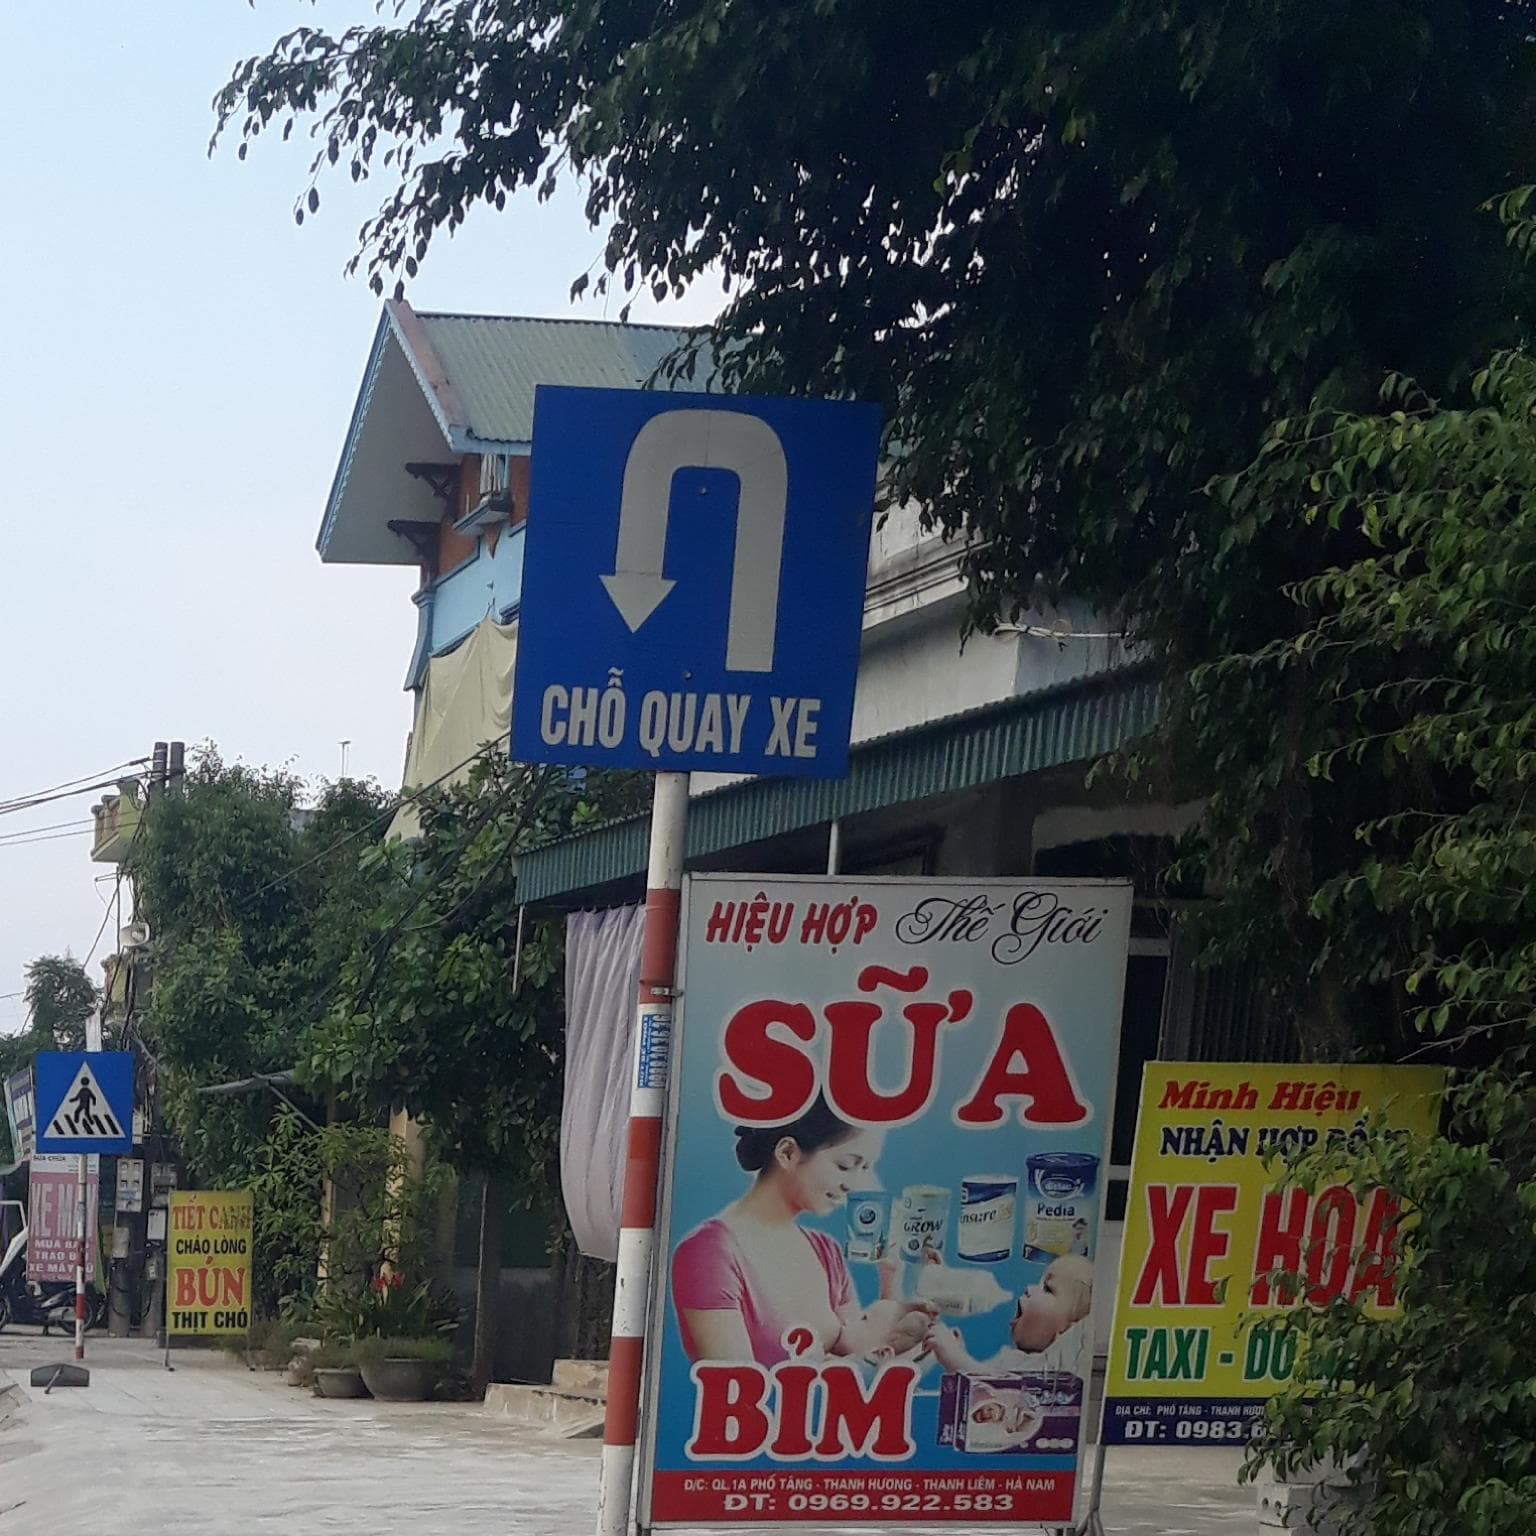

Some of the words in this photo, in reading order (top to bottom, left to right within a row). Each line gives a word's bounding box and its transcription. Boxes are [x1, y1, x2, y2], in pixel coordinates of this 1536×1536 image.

[541, 667, 626, 750] CHỖ
[639, 690, 751, 758] QUAY
[764, 697, 821, 759] XE
[706, 892, 790, 952] HIỆU
[800, 896, 878, 955] HỢP
[895, 894, 1005, 945] Thế
[991, 891, 1109, 966] Giới
[718, 965, 1090, 1123] SỮA
[1159, 1080, 1258, 1111] Minh
[1268, 1081, 1362, 1117] Hiệu
[1160, 1119, 1249, 1163] NHẬN
[32, 1183, 52, 1238] XE
[172, 1194, 206, 1231] TIẾT
[961, 1209, 997, 1225] nsure
[1037, 1202, 1075, 1217] Pedia
[35, 1240, 61, 1249] MUA
[35, 1251, 64, 1261] TRAO
[176, 1234, 210, 1256] CHÁO
[214, 1234, 246, 1255] LÒNG
[1133, 1186, 1237, 1305] XE
[1250, 1186, 1400, 1306] HOA
[175, 1256, 246, 1307] BÚN
[172, 1311, 208, 1333] THỊT
[214, 1307, 248, 1329] CHÓ
[1126, 1329, 1207, 1379] TAXI
[690, 1328, 915, 1455] BỈM
[1124, 1420, 1167, 1438] ĐT:
[1175, 1420, 1266, 1438] 0983.6
[750, 1474, 776, 1490] PHỐ
[824, 1479, 864, 1490] THANH
[924, 1478, 964, 1490] THANH
[967, 1475, 995, 1490] LIÊM
[1005, 1475, 1023, 1490] HÀ
[1026, 1479, 1055, 1490] NAM
[723, 1494, 776, 1511] ĐT:
[788, 1493, 1013, 1512] 0969.922.583
